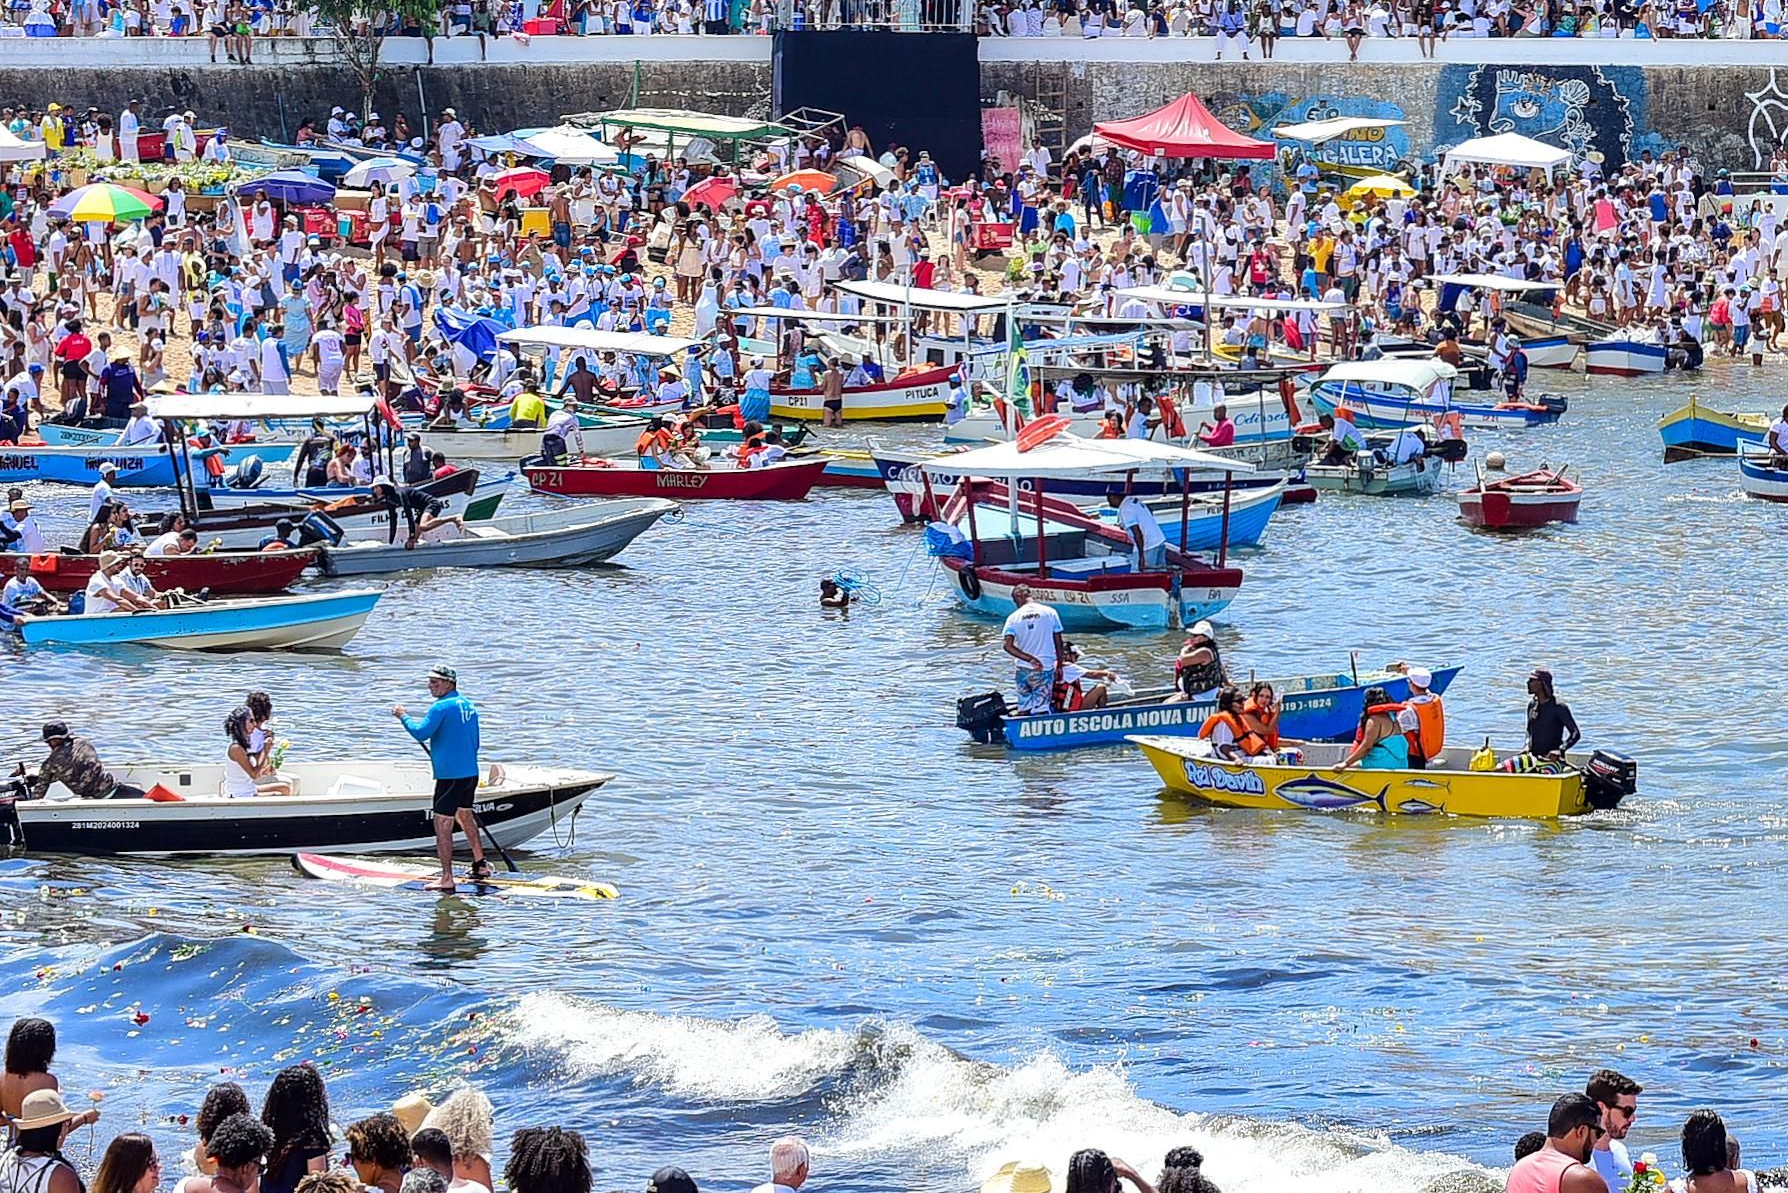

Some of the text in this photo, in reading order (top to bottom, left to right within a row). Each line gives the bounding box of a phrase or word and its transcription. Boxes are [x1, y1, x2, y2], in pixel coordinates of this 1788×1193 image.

[905, 387, 939, 400] PITUCA
[656, 473, 708, 488] MARLEY
[1110, 593, 1130, 604] SSA
[1207, 589, 1222, 600] BA
[1019, 718, 1065, 738] AUTO
[1136, 710, 1183, 728] NOVA
[71, 821, 140, 830] 281M2024001324
